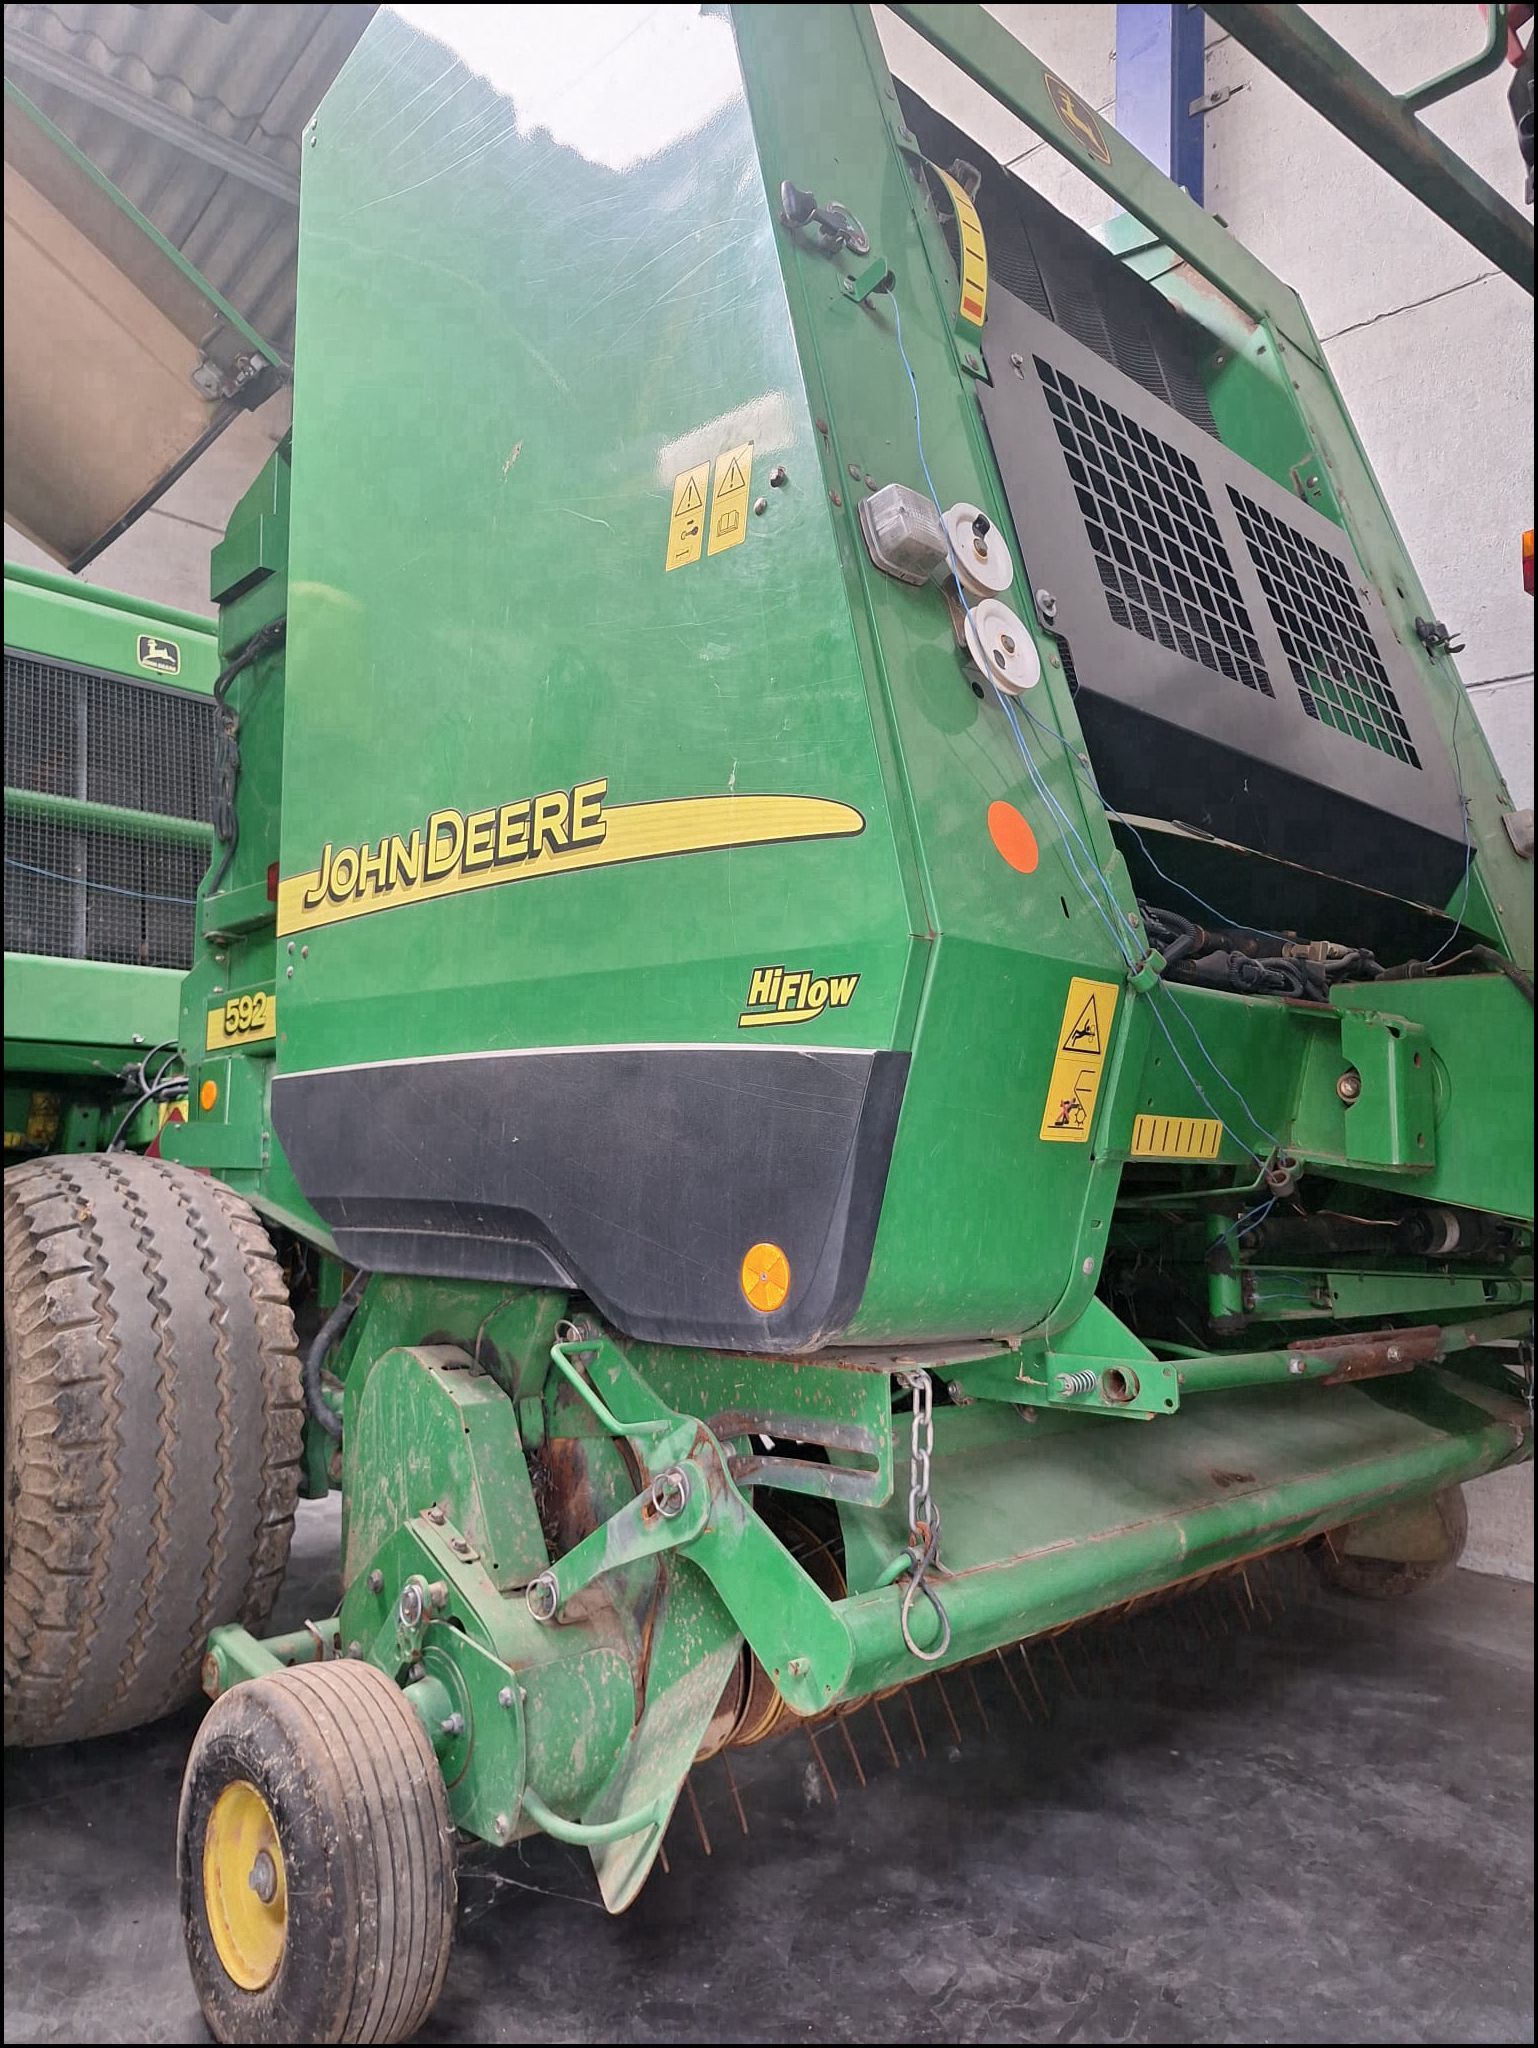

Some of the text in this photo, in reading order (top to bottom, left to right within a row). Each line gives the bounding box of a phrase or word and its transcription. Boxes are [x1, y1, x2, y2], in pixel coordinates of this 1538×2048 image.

[305, 778, 608, 908] JOHN DEERE
[747, 965, 861, 1012] HiFlow
[225, 991, 267, 1035] 592
